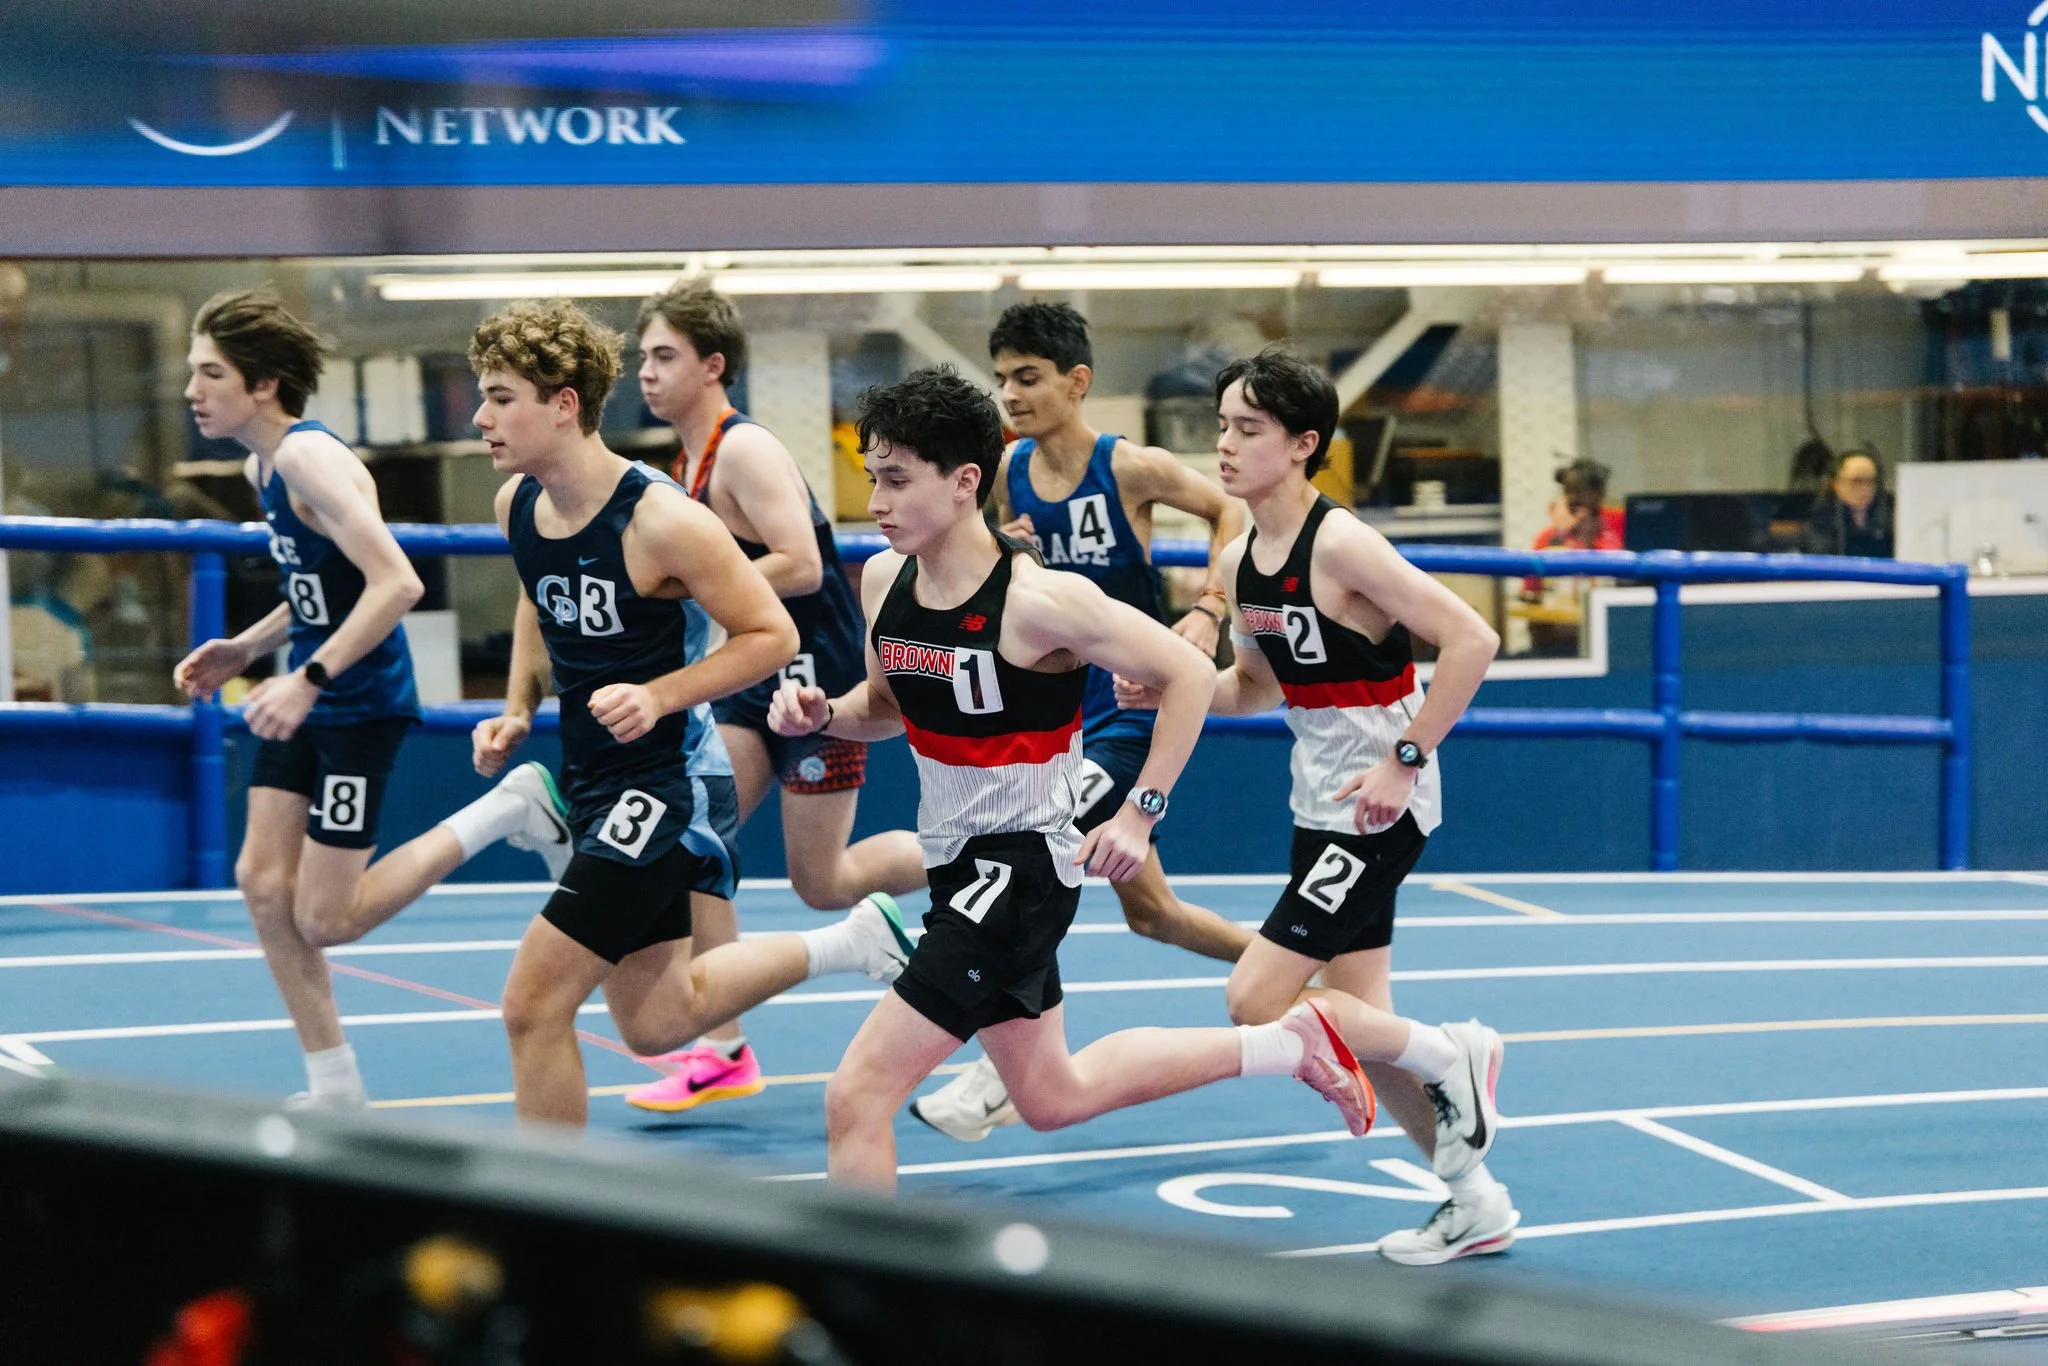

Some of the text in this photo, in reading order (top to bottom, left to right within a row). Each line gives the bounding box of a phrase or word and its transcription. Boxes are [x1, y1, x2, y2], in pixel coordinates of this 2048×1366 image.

[1981, 31, 2048, 102] N
[376, 106, 686, 145] NETWORK
[1079, 501, 1106, 545] 4
[295, 579, 319, 620] 8
[585, 581, 613, 633] 3
[1287, 610, 1318, 660] 2
[959, 654, 985, 710] 1
[329, 781, 357, 826] 8
[609, 795, 653, 846] 3
[1306, 852, 1353, 906] 2
